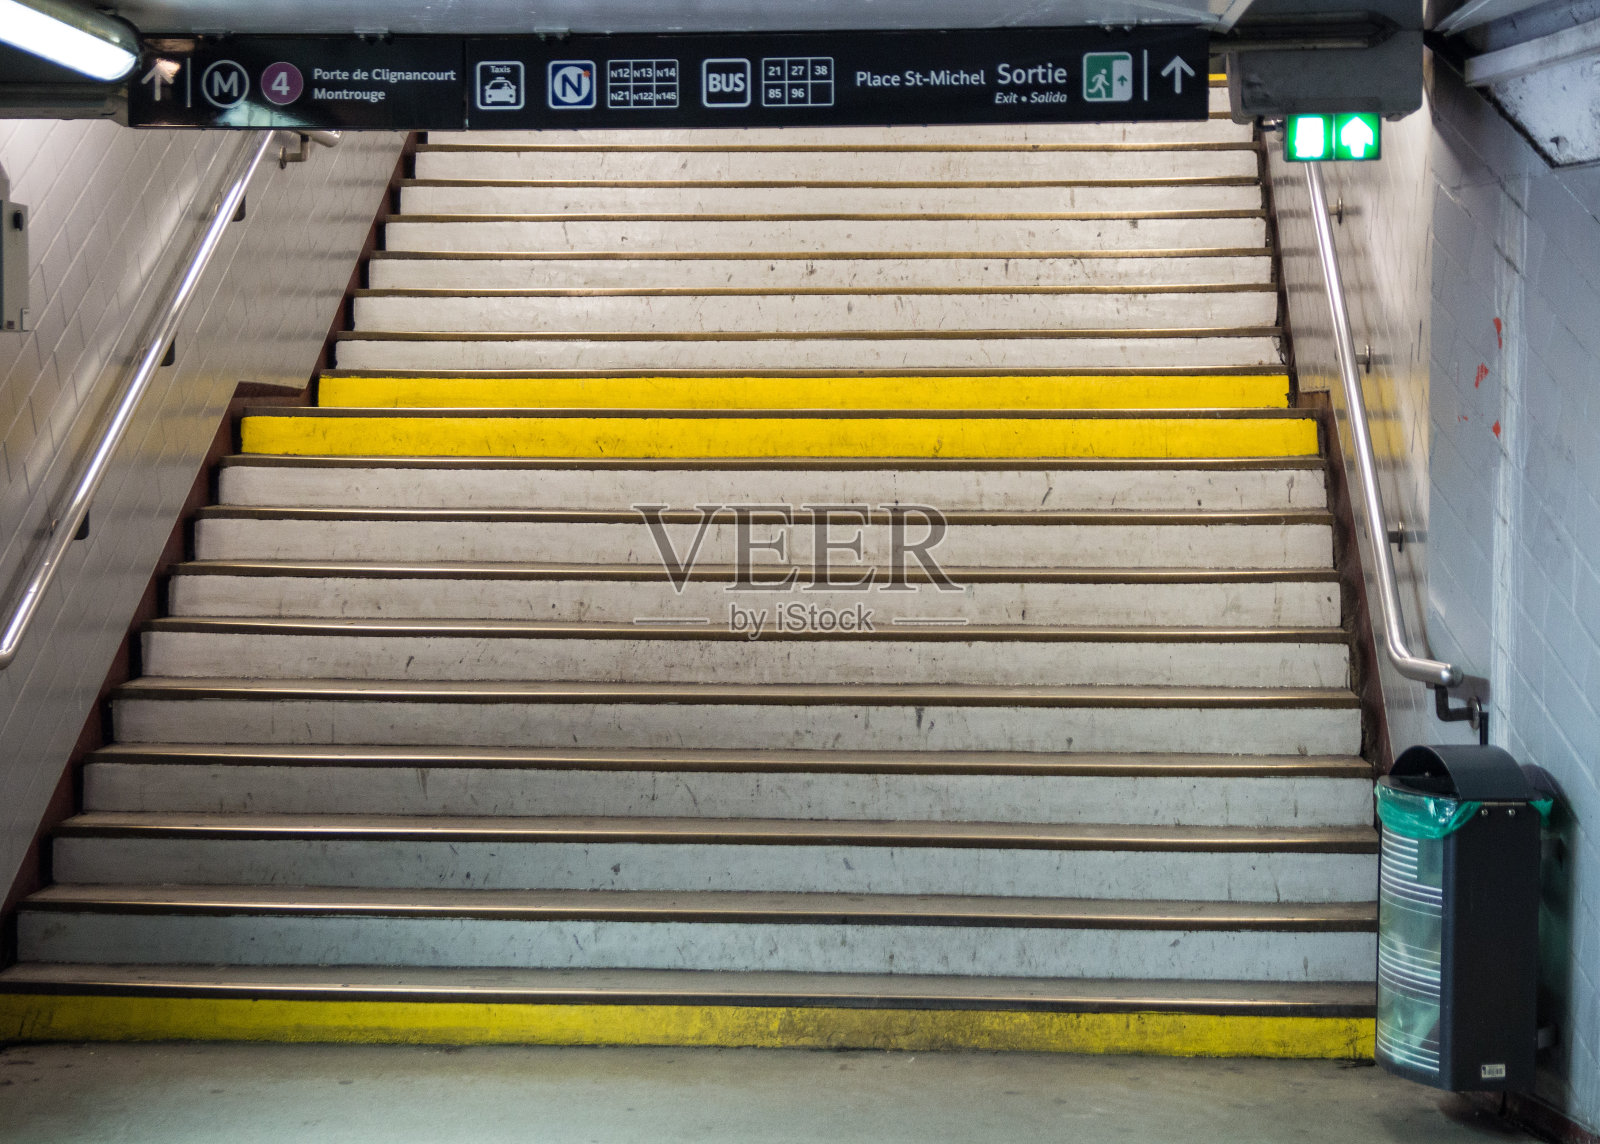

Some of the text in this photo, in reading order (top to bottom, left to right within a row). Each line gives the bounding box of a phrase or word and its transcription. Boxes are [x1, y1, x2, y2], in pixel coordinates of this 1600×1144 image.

[314, 68, 456, 83] Porte de Clignancourt
[490, 65, 511, 74] Taxis
[611, 67, 677, 79] N12 N13 N14
[768, 65, 828, 76] 21 27 38
[997, 63, 1068, 85] Sortie
[213, 71, 238, 97] M
[271, 72, 290, 96] 4
[708, 72, 745, 93] BUS
[856, 70, 986, 87] Place St-Michel
[314, 88, 386, 103] Montrouge
[611, 90, 677, 101] N21 N122 N145
[768, 88, 805, 98] 85 96
[995, 92, 1068, 104] Exit Salida
